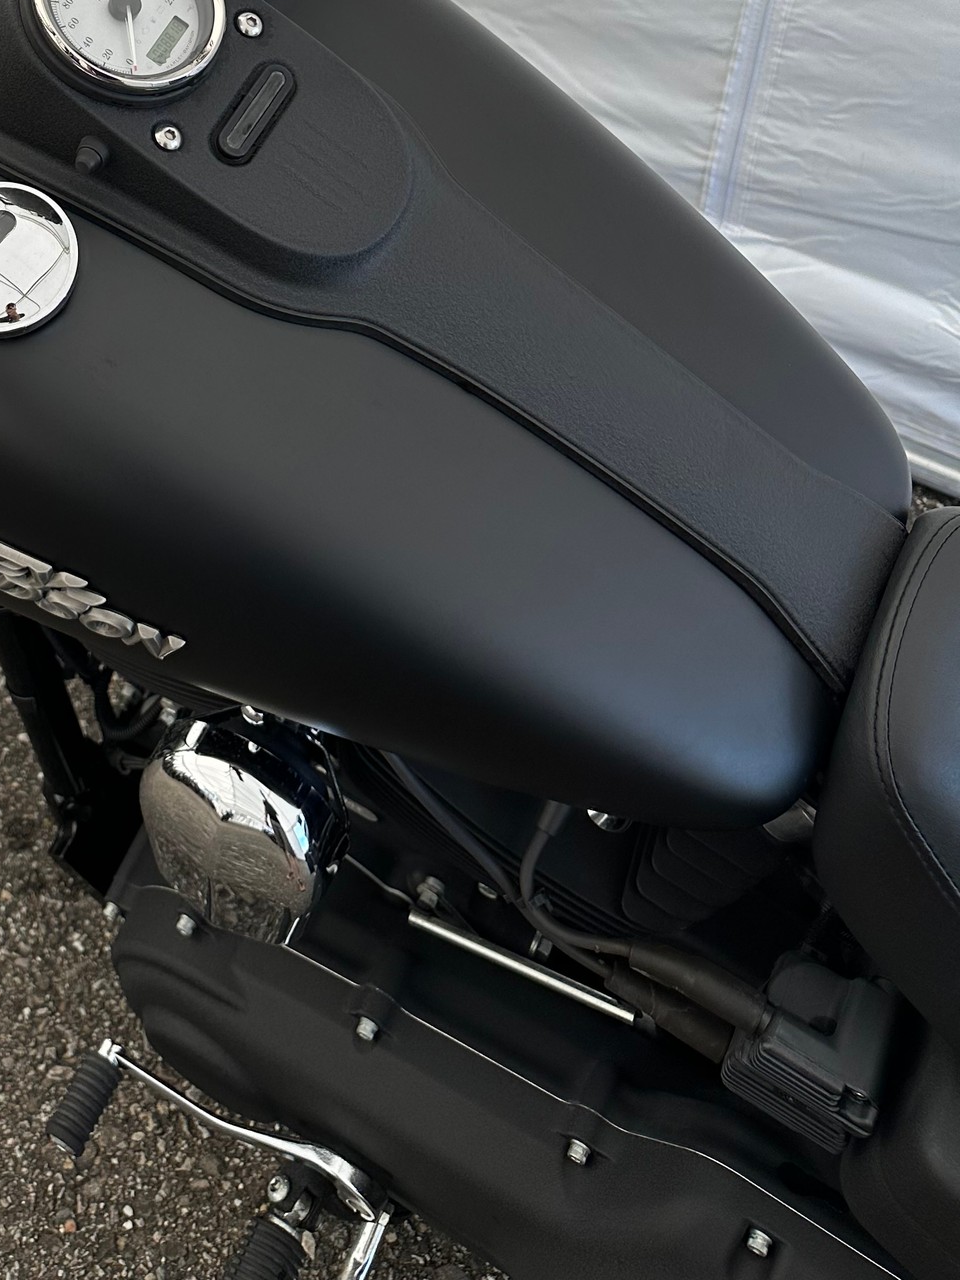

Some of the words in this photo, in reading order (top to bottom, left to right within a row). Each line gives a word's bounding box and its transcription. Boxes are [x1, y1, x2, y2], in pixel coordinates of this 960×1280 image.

[68, 17, 80, 30] 60
[83, 36, 94, 48] 40
[102, 48, 114, 61] 20
[126, 58, 134, 66] 0
